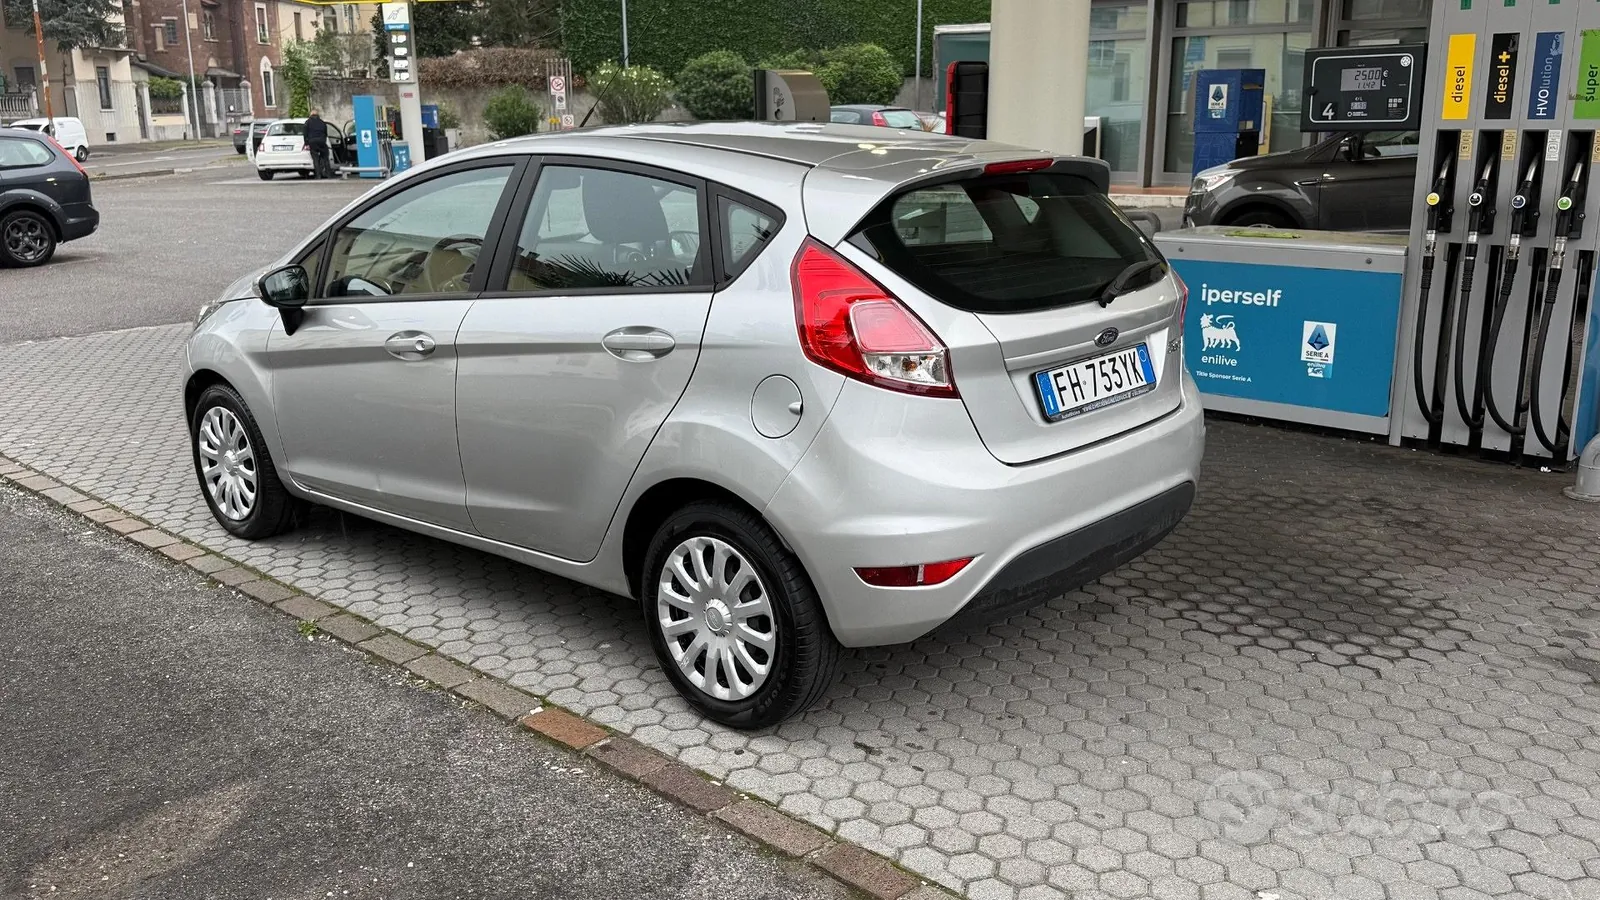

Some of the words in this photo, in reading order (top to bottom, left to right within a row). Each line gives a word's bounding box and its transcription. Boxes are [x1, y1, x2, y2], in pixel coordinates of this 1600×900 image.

[1383, 70, 1389, 78] €
[1452, 66, 1466, 103] diesel
[1585, 64, 1599, 102] super
[1536, 57, 1553, 116] HVOlution
[1322, 102, 1335, 120] 4
[1201, 283, 1283, 308] iperself
[1201, 354, 1238, 367] enilive
[1305, 350, 1323, 358] SERIE
[1053, 367, 1086, 407] FH
[1085, 350, 1144, 398] 753YK
[1209, 372, 1231, 380] Sponsor
